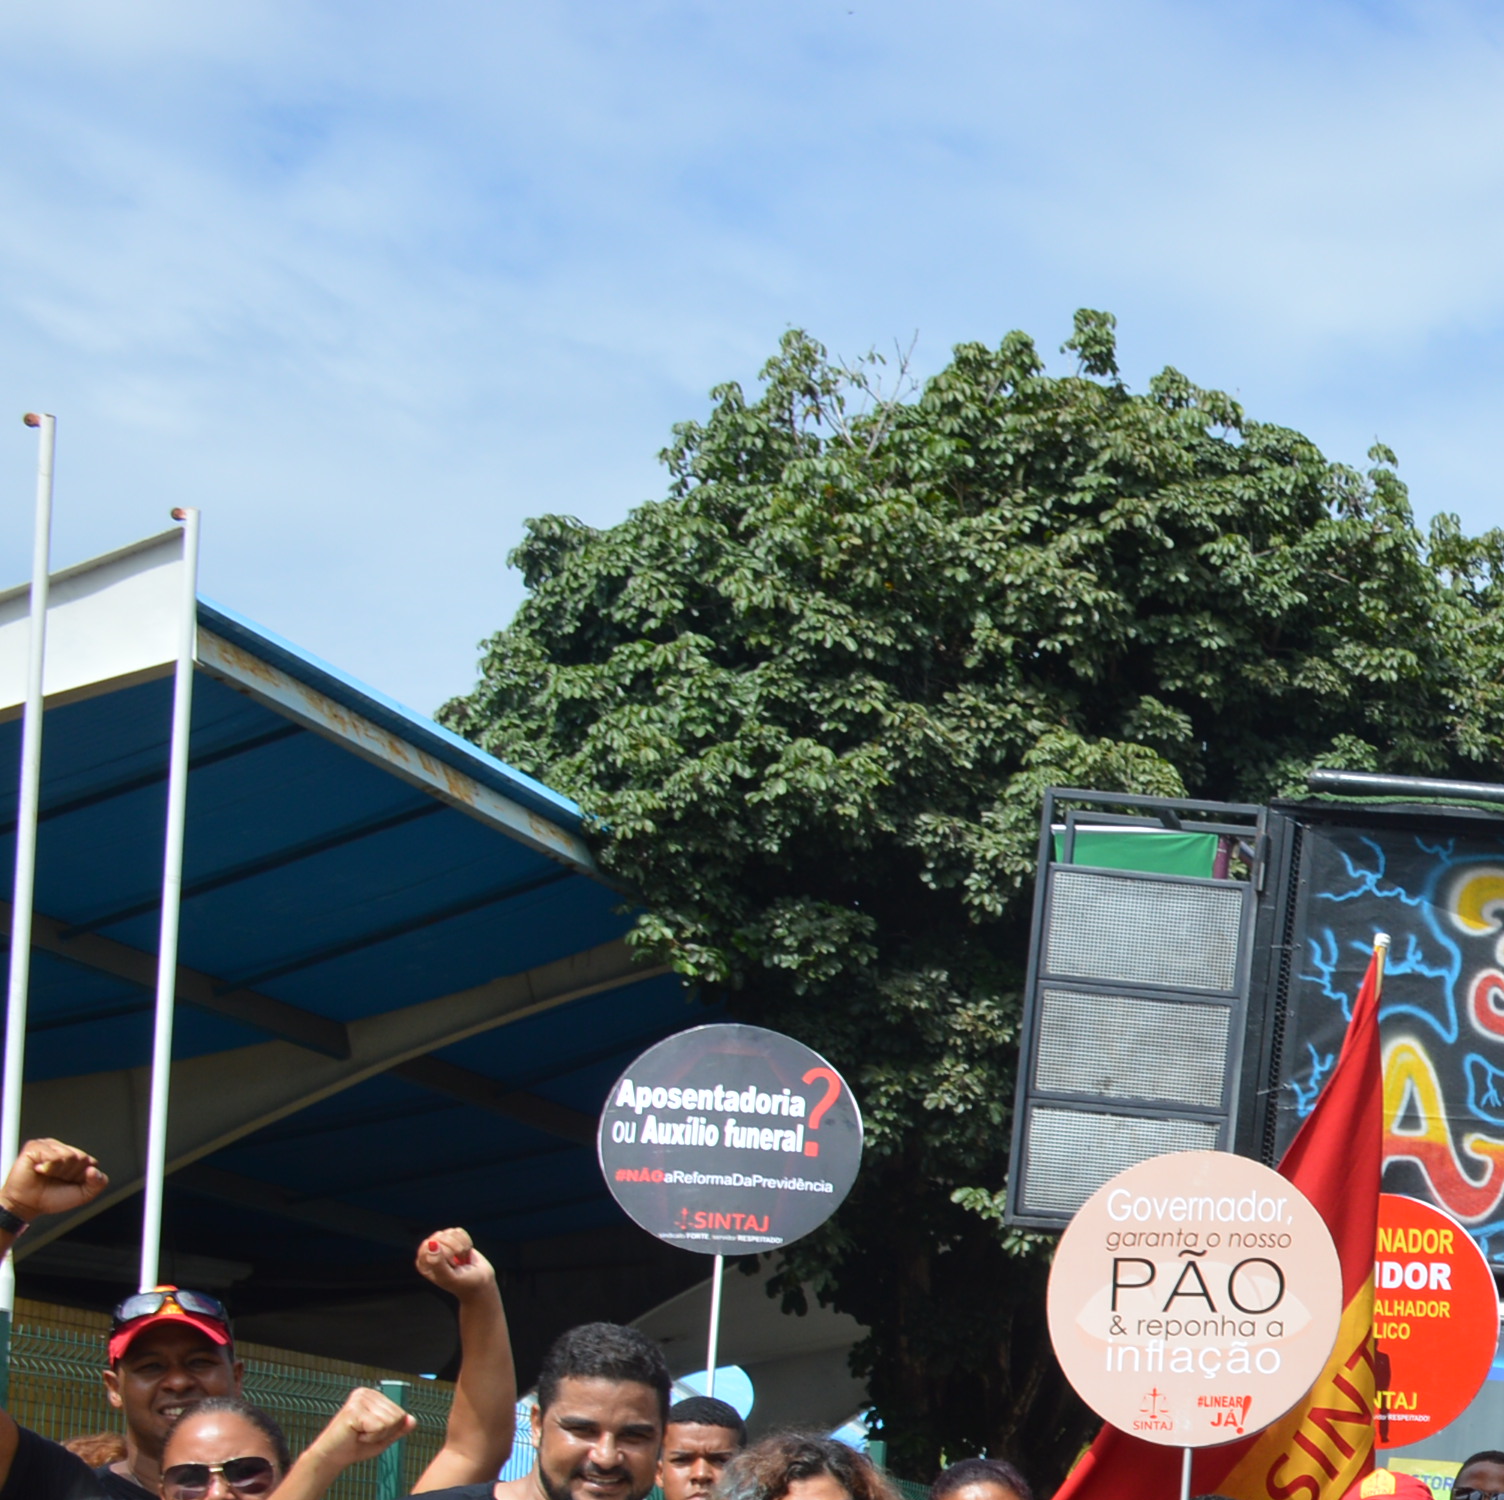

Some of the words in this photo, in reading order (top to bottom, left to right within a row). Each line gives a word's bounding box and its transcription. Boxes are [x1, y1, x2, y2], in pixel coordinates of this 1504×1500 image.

[615, 1077, 806, 1118] Aposentadoria
[612, 1119, 638, 1145] ou
[640, 1114, 720, 1148] Auxílio
[1106, 1187, 1294, 1226] Governador,
[692, 1210, 770, 1233] SINTAJ
[737, 1234, 784, 1245] RESPEITADO!
[1106, 1228, 1200, 1252] garanta
[1206, 1231, 1221, 1249] o
[1228, 1231, 1293, 1249] nosso
[1110, 1248, 1287, 1316] PÃO
[1108, 1314, 1128, 1337] &
[1137, 1314, 1257, 1342] reponha
[1266, 1319, 1285, 1338] a
[1105, 1337, 1282, 1380] inflação
[1197, 1394, 1244, 1409] #LINEAR
[1132, 1418, 1174, 1432] SINTAJ
[1386, 1413, 1432, 1423] RESPEITADO!
